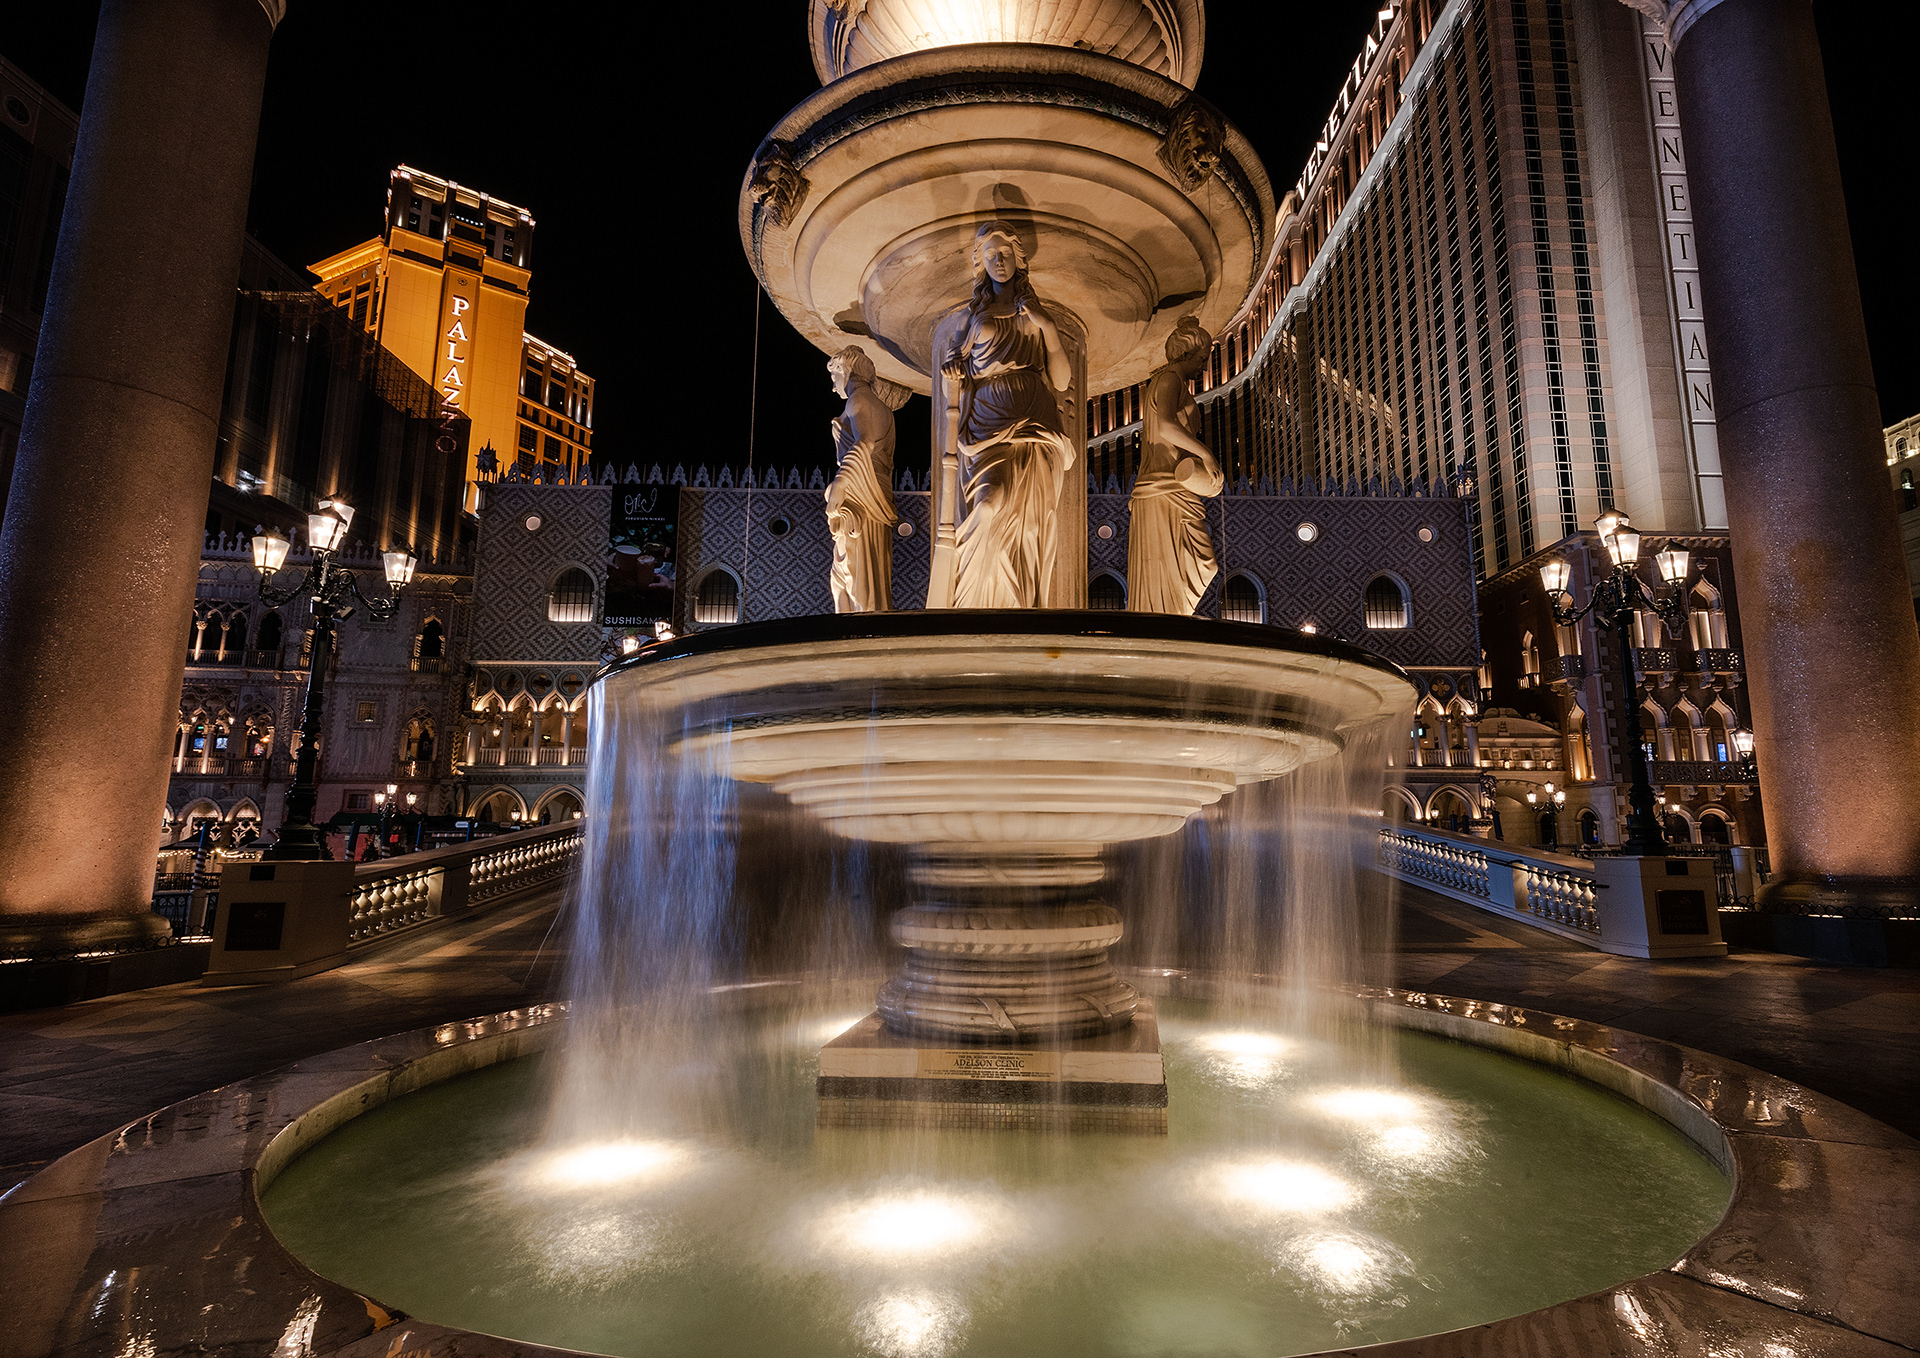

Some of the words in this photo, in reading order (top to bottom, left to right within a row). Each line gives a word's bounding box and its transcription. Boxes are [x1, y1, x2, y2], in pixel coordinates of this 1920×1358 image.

[1296, 3, 1394, 201] VENETIAN
[1649, 42, 1713, 413] VENETIAN
[435, 294, 470, 454] PALAZZO
[604, 616, 670, 625] SUSHISAM
[954, 1058, 993, 1067] ADELSON
[995, 1059, 1025, 1068] CLINIC
